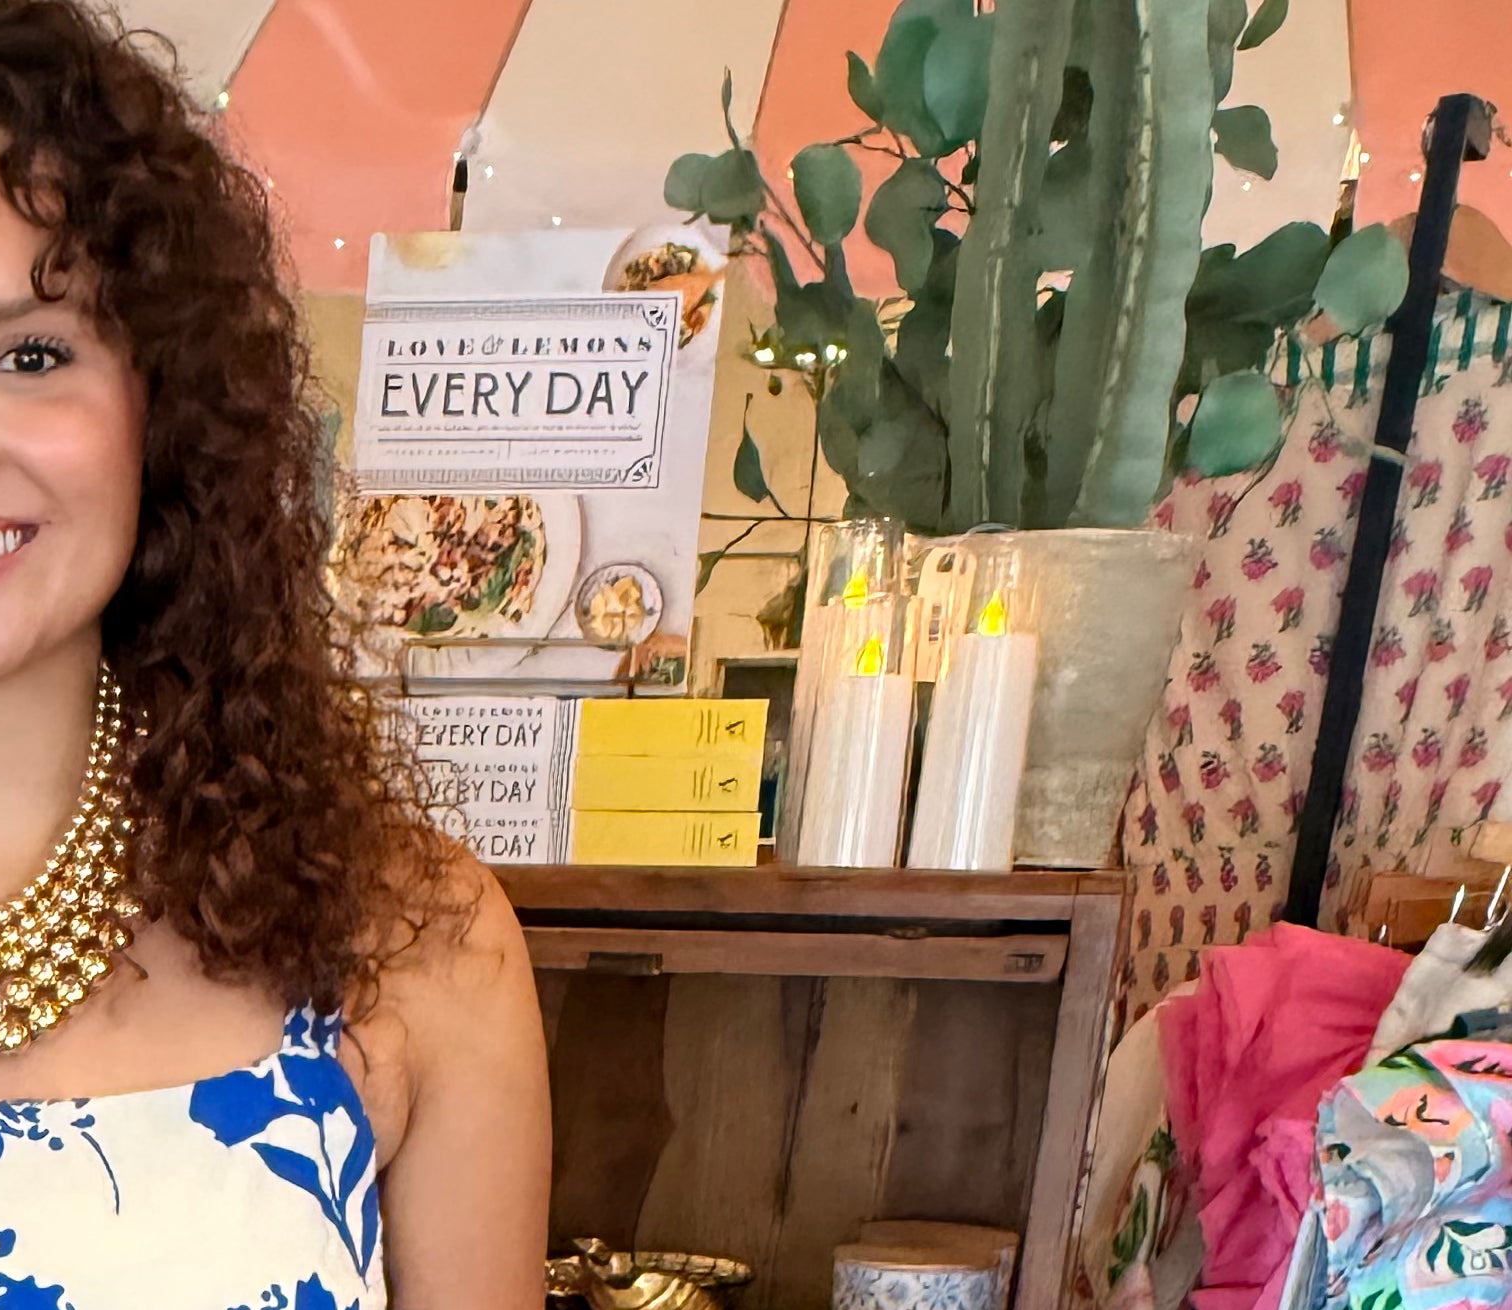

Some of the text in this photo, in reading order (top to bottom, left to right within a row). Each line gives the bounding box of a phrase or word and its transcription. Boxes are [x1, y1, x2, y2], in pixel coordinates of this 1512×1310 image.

[387, 336, 475, 357] LOVE
[510, 335, 653, 357] LEMONS
[380, 370, 649, 418] EVERY DAY
[419, 722, 542, 748] EVERY DAY
[490, 778, 536, 804] DAY
[490, 833, 536, 859] DAY
